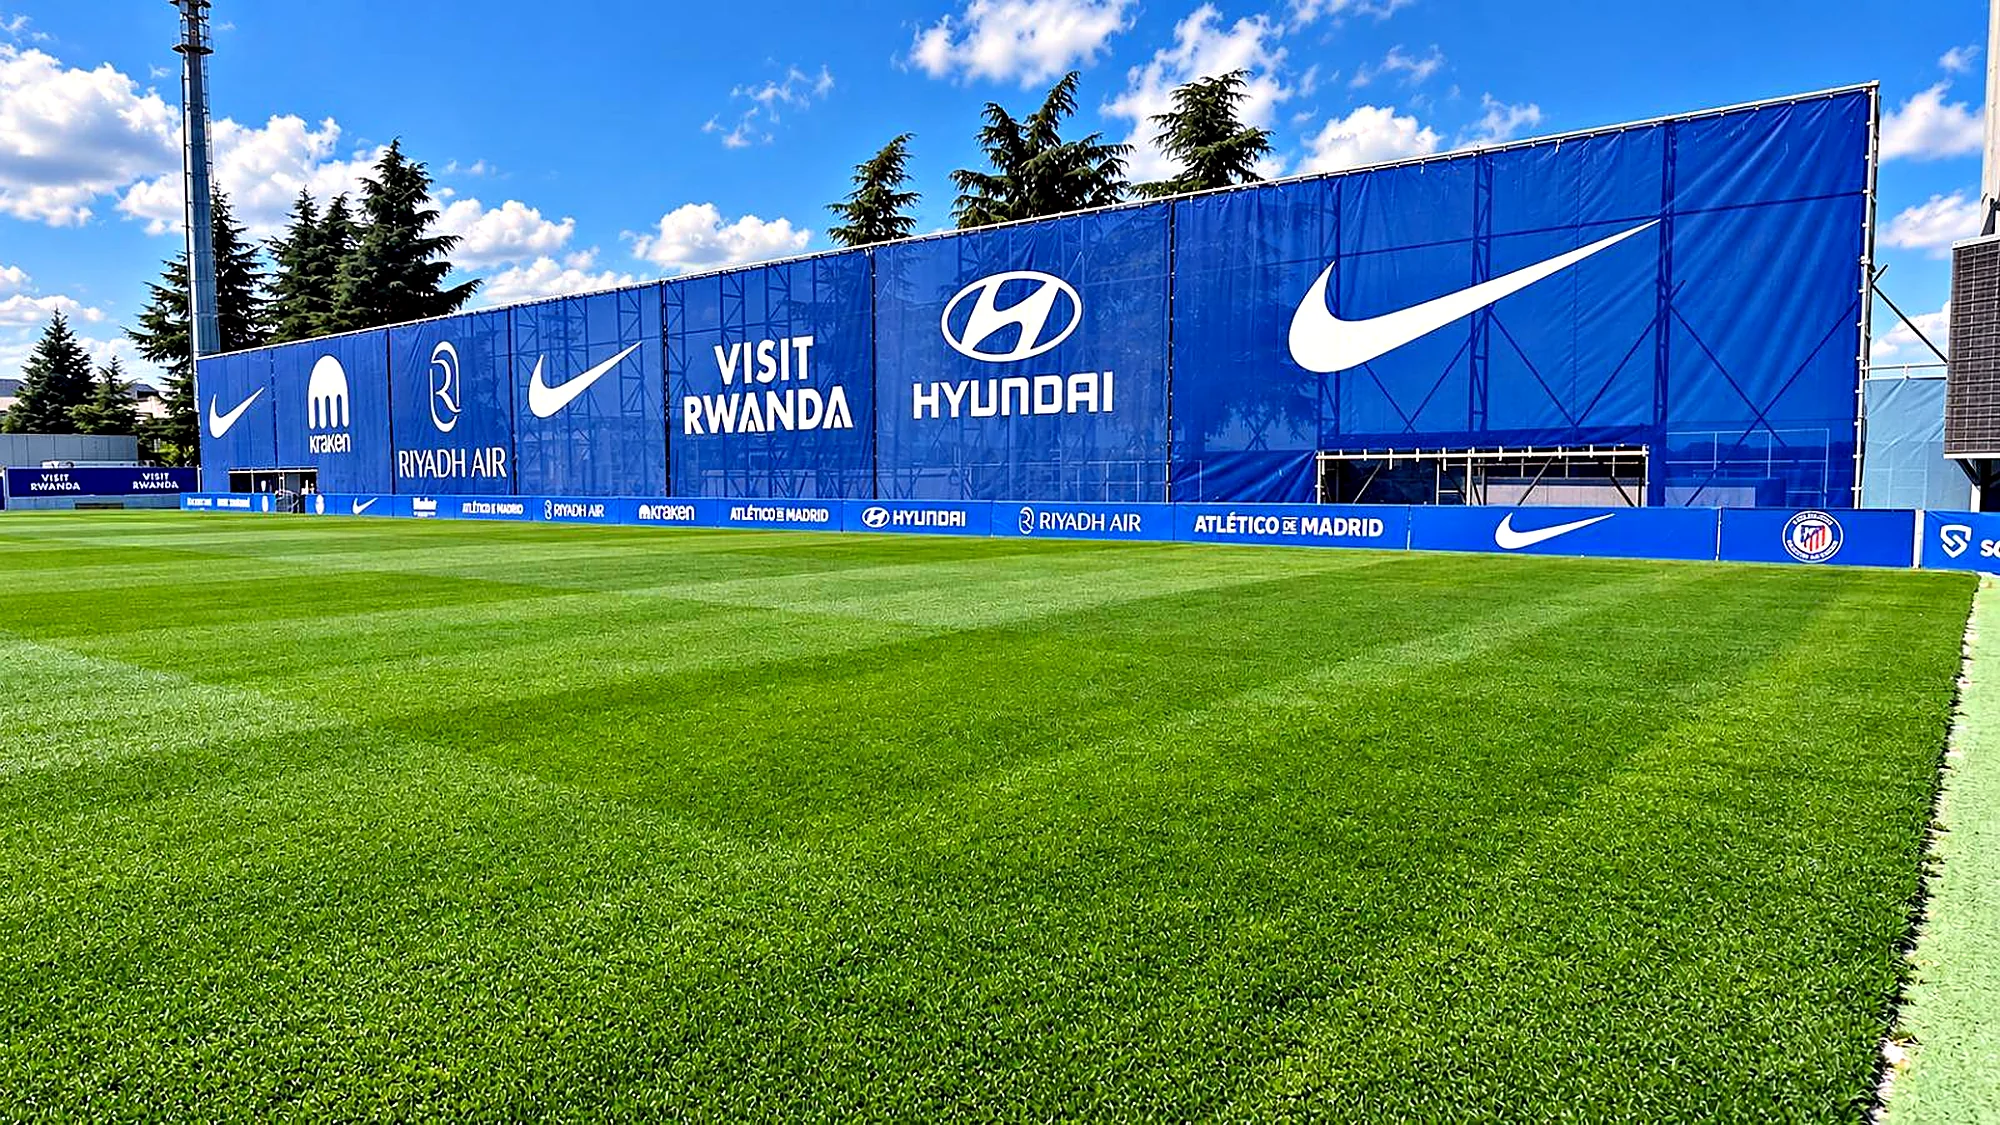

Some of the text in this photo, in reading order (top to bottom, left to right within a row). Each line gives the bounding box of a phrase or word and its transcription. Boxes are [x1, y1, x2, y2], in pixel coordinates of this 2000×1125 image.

[714, 335, 814, 385] VISIT
[913, 371, 1113, 420] HYUNDAI
[683, 383, 854, 435] RWANDA
[398, 447, 507, 478] RIYADH AIR
[41, 473, 69, 482] VISIT
[132, 481, 179, 490] RWANDA
[142, 472, 169, 481] VISIT
[30, 482, 81, 491] RWANDA
[553, 503, 605, 518] RIYADH AIR
[730, 504, 775, 521] ATLÉTICO
[785, 508, 829, 522] MADRID
[892, 510, 966, 527] HYUNDAI
[1039, 512, 1141, 532] RIYADH AIR
[1194, 511, 1384, 537] ATLÉTICO DE MADRID
